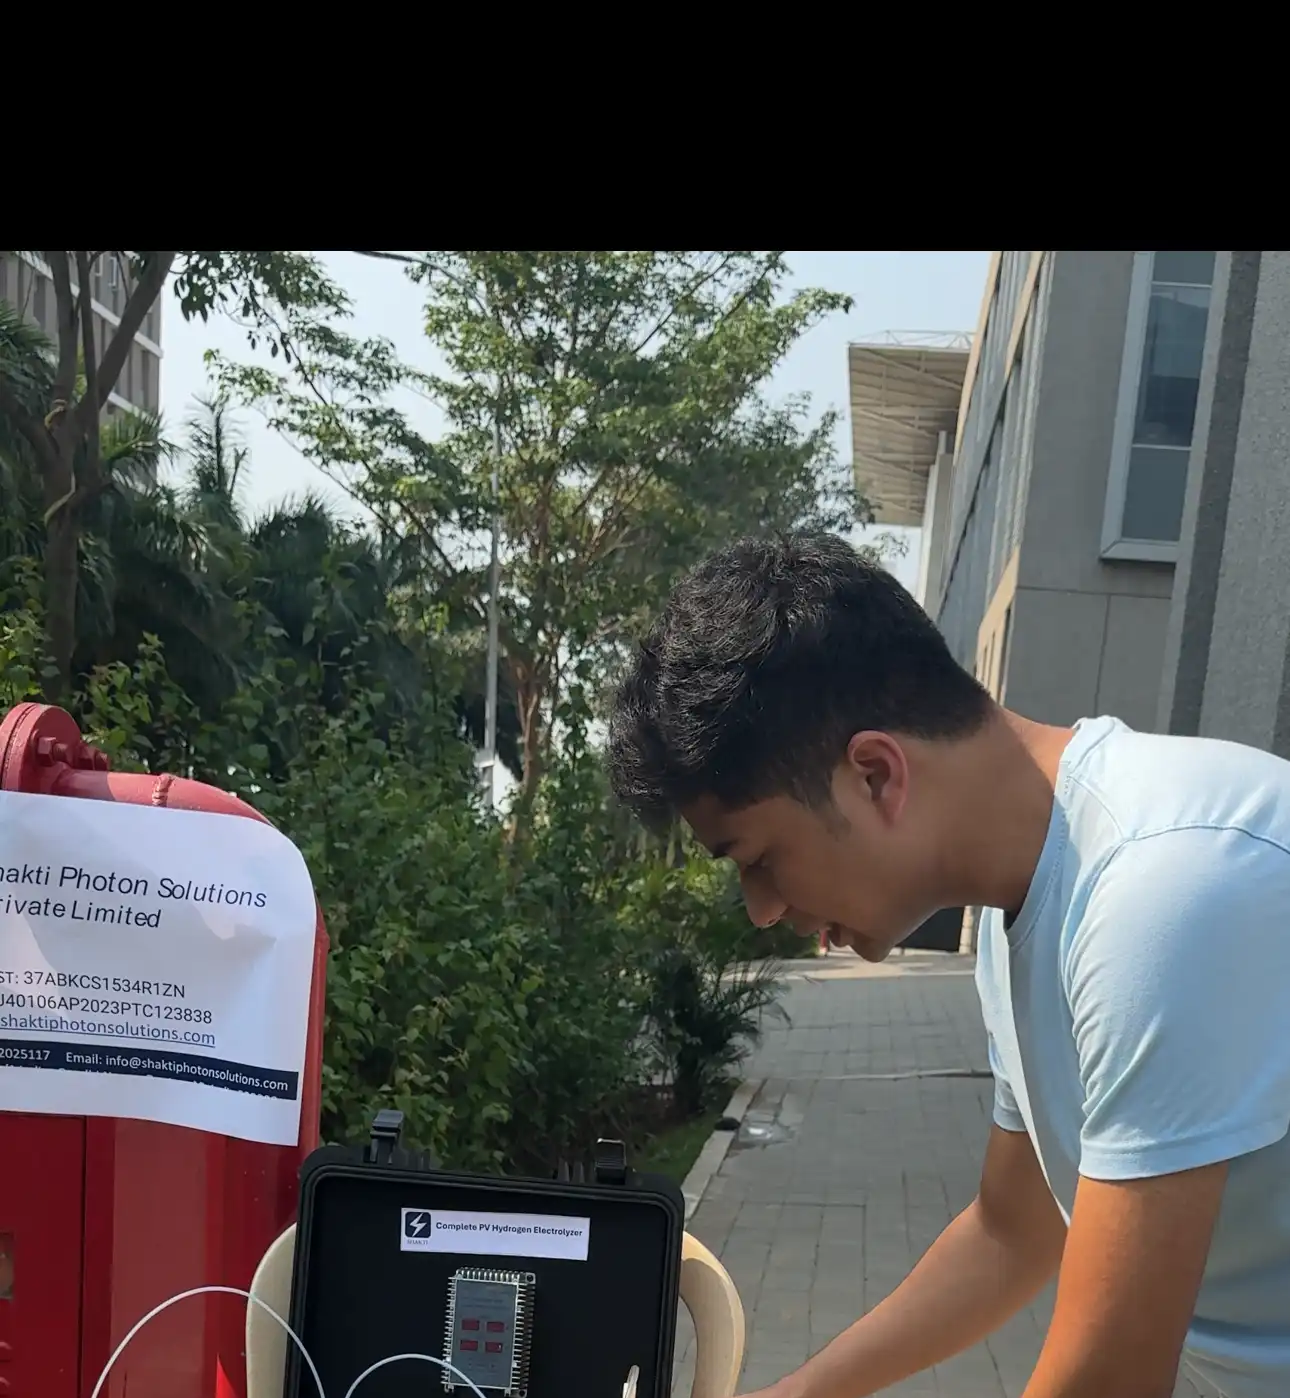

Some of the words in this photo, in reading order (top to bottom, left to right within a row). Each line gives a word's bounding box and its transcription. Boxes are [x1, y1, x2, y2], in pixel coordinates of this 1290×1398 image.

[59, 866, 148, 896] Photon
[157, 878, 267, 908] Solutions
[0, 894, 66, 918] ivate
[71, 900, 162, 928] Limited
[23, 970, 185, 998] 37ABKCS1534R1ZN
[65, 1052, 103, 1065] Email:
[105, 1055, 289, 1091] info@shaktiphotonsolutions.com
[435, 1221, 478, 1231] Complete
[479, 1223, 491, 1232] PV
[491, 1224, 532, 1235] Hydrogen
[533, 1226, 583, 1237] Electrolyzer
